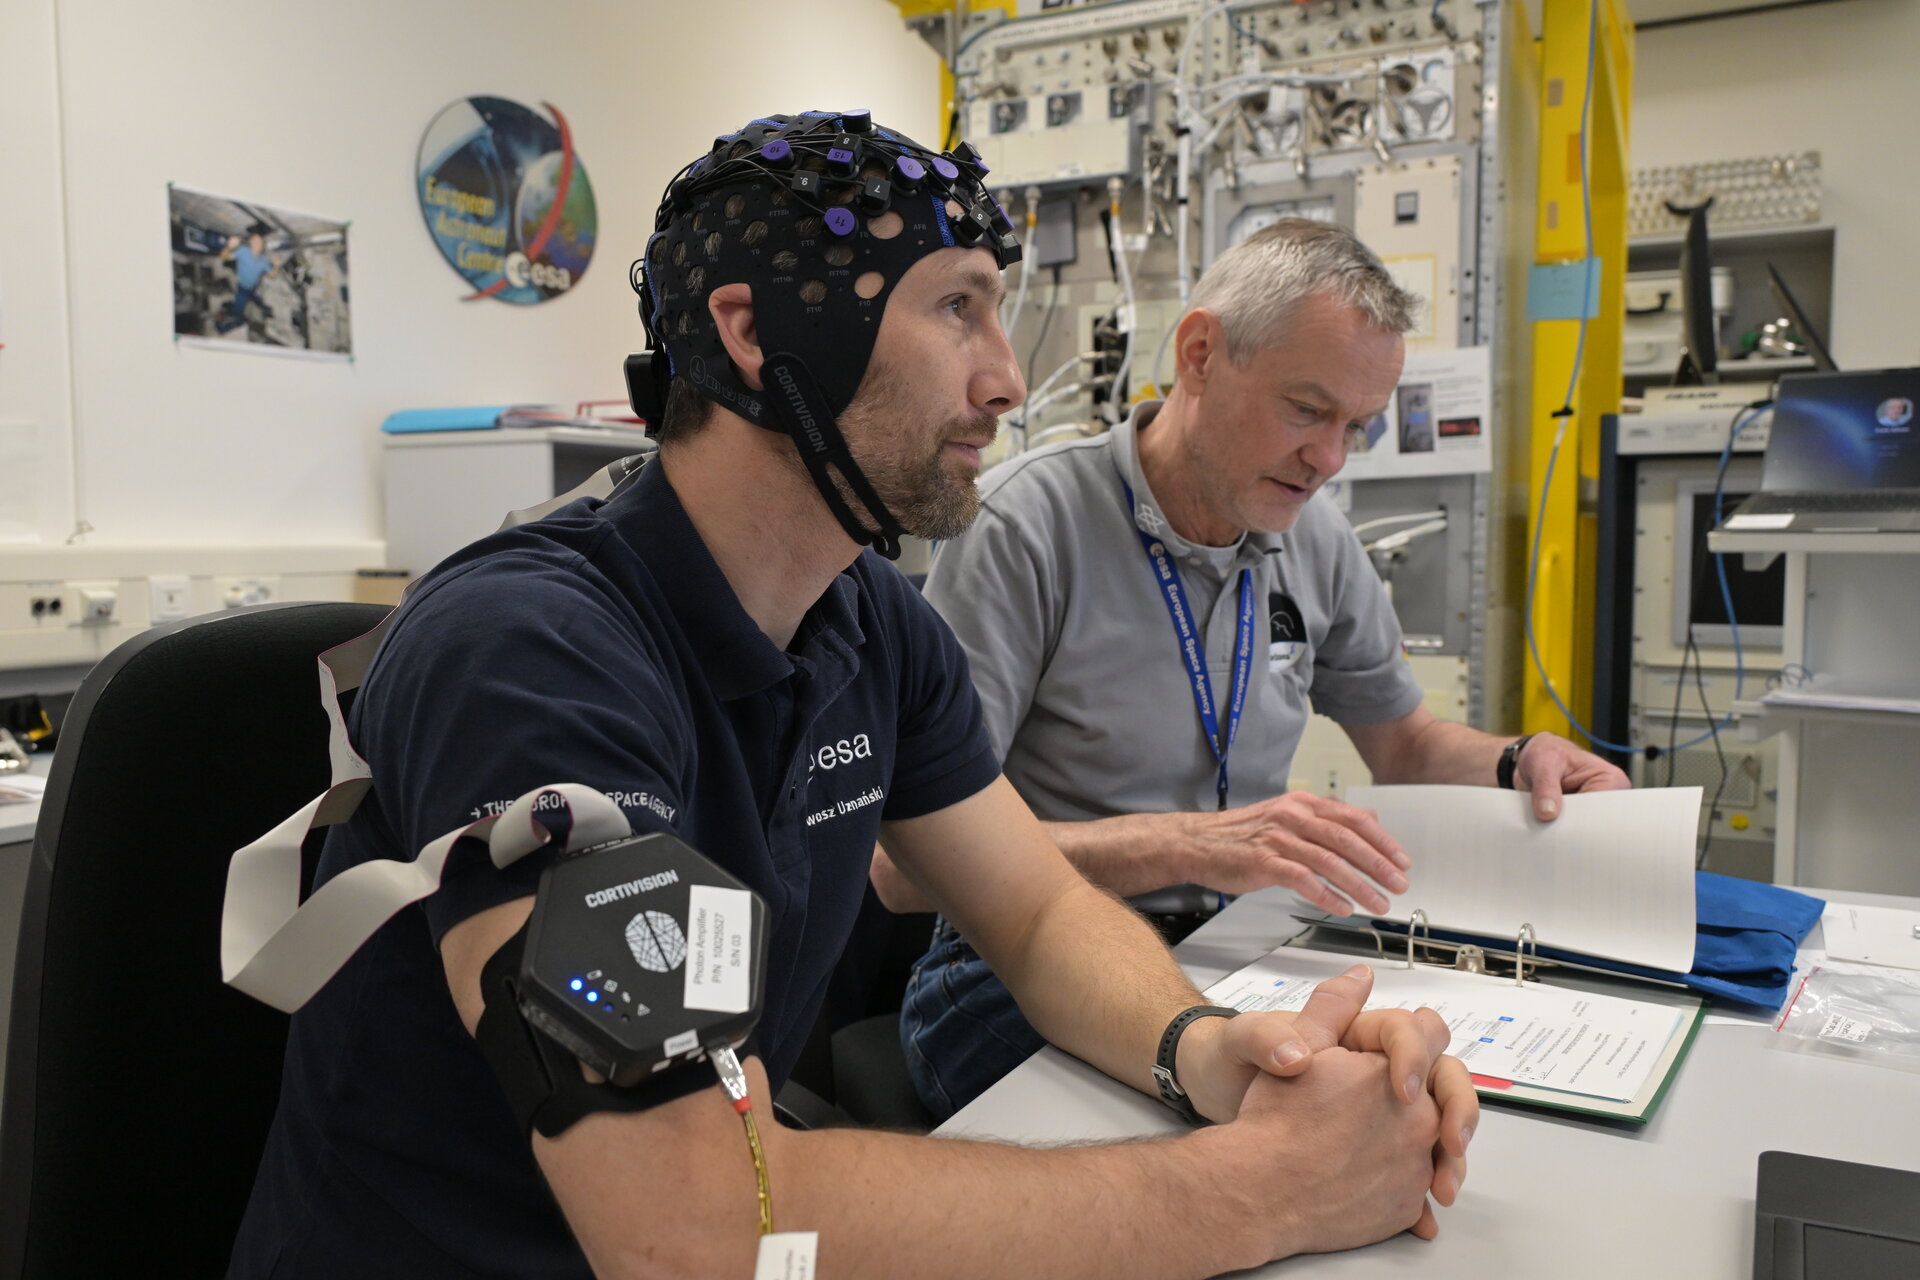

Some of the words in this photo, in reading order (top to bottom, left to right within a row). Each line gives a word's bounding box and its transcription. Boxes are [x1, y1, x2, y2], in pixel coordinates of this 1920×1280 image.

[833, 151, 845, 159] 15
[425, 183, 496, 217] European
[873, 184, 881, 193] 7
[834, 215, 846, 227] 11
[773, 365, 827, 453] CORTIVISION
[1167, 583, 1190, 637] European
[1185, 638, 1201, 673] Space
[1195, 674, 1211, 715] Agency
[1240, 625, 1251, 657] Space
[1233, 660, 1248, 712] European
[817, 733, 873, 770] esa
[836, 786, 884, 815] Uznański
[584, 869, 679, 908] CORTIVISION
[695, 907, 708, 949] Amplifier
[731, 934, 742, 947] 03
[693, 950, 705, 985] Photon
[730, 948, 741, 967] S/N
